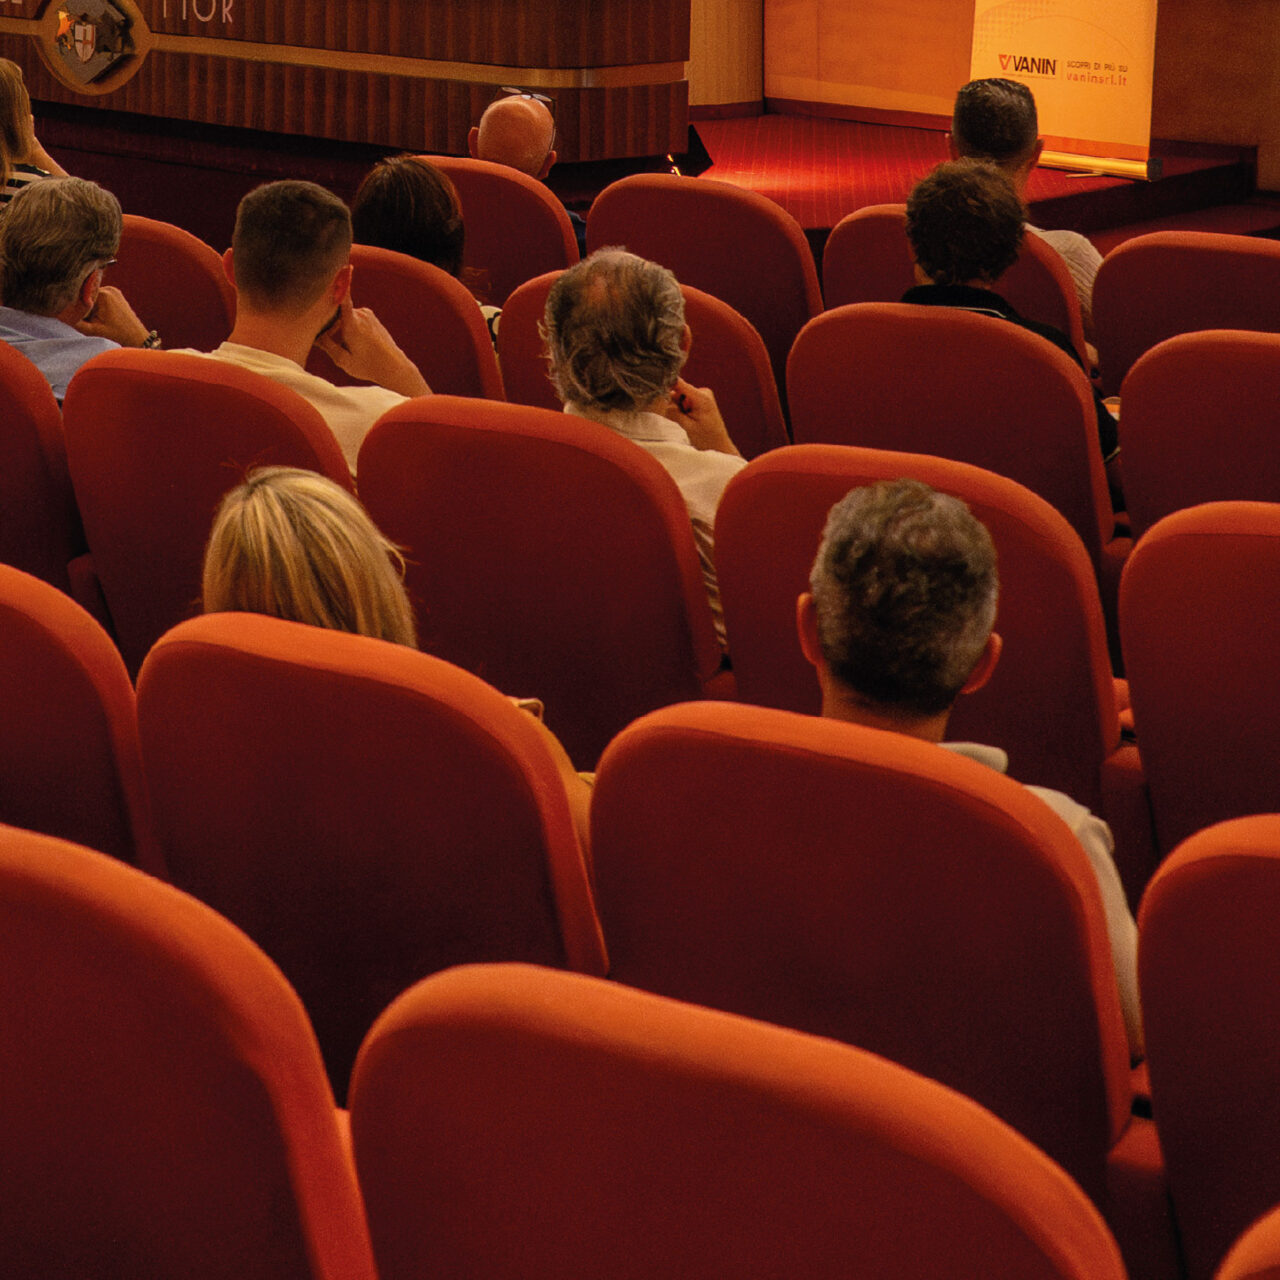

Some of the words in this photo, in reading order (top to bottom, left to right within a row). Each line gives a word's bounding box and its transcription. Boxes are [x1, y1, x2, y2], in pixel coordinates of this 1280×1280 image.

[1013, 55, 1057, 75] VANIN
[1067, 61, 1091, 70] SCOPRI
[1093, 62, 1101, 70] DI
[1118, 64, 1128, 73] SU
[1067, 72, 1127, 87] vaninsrl.it
